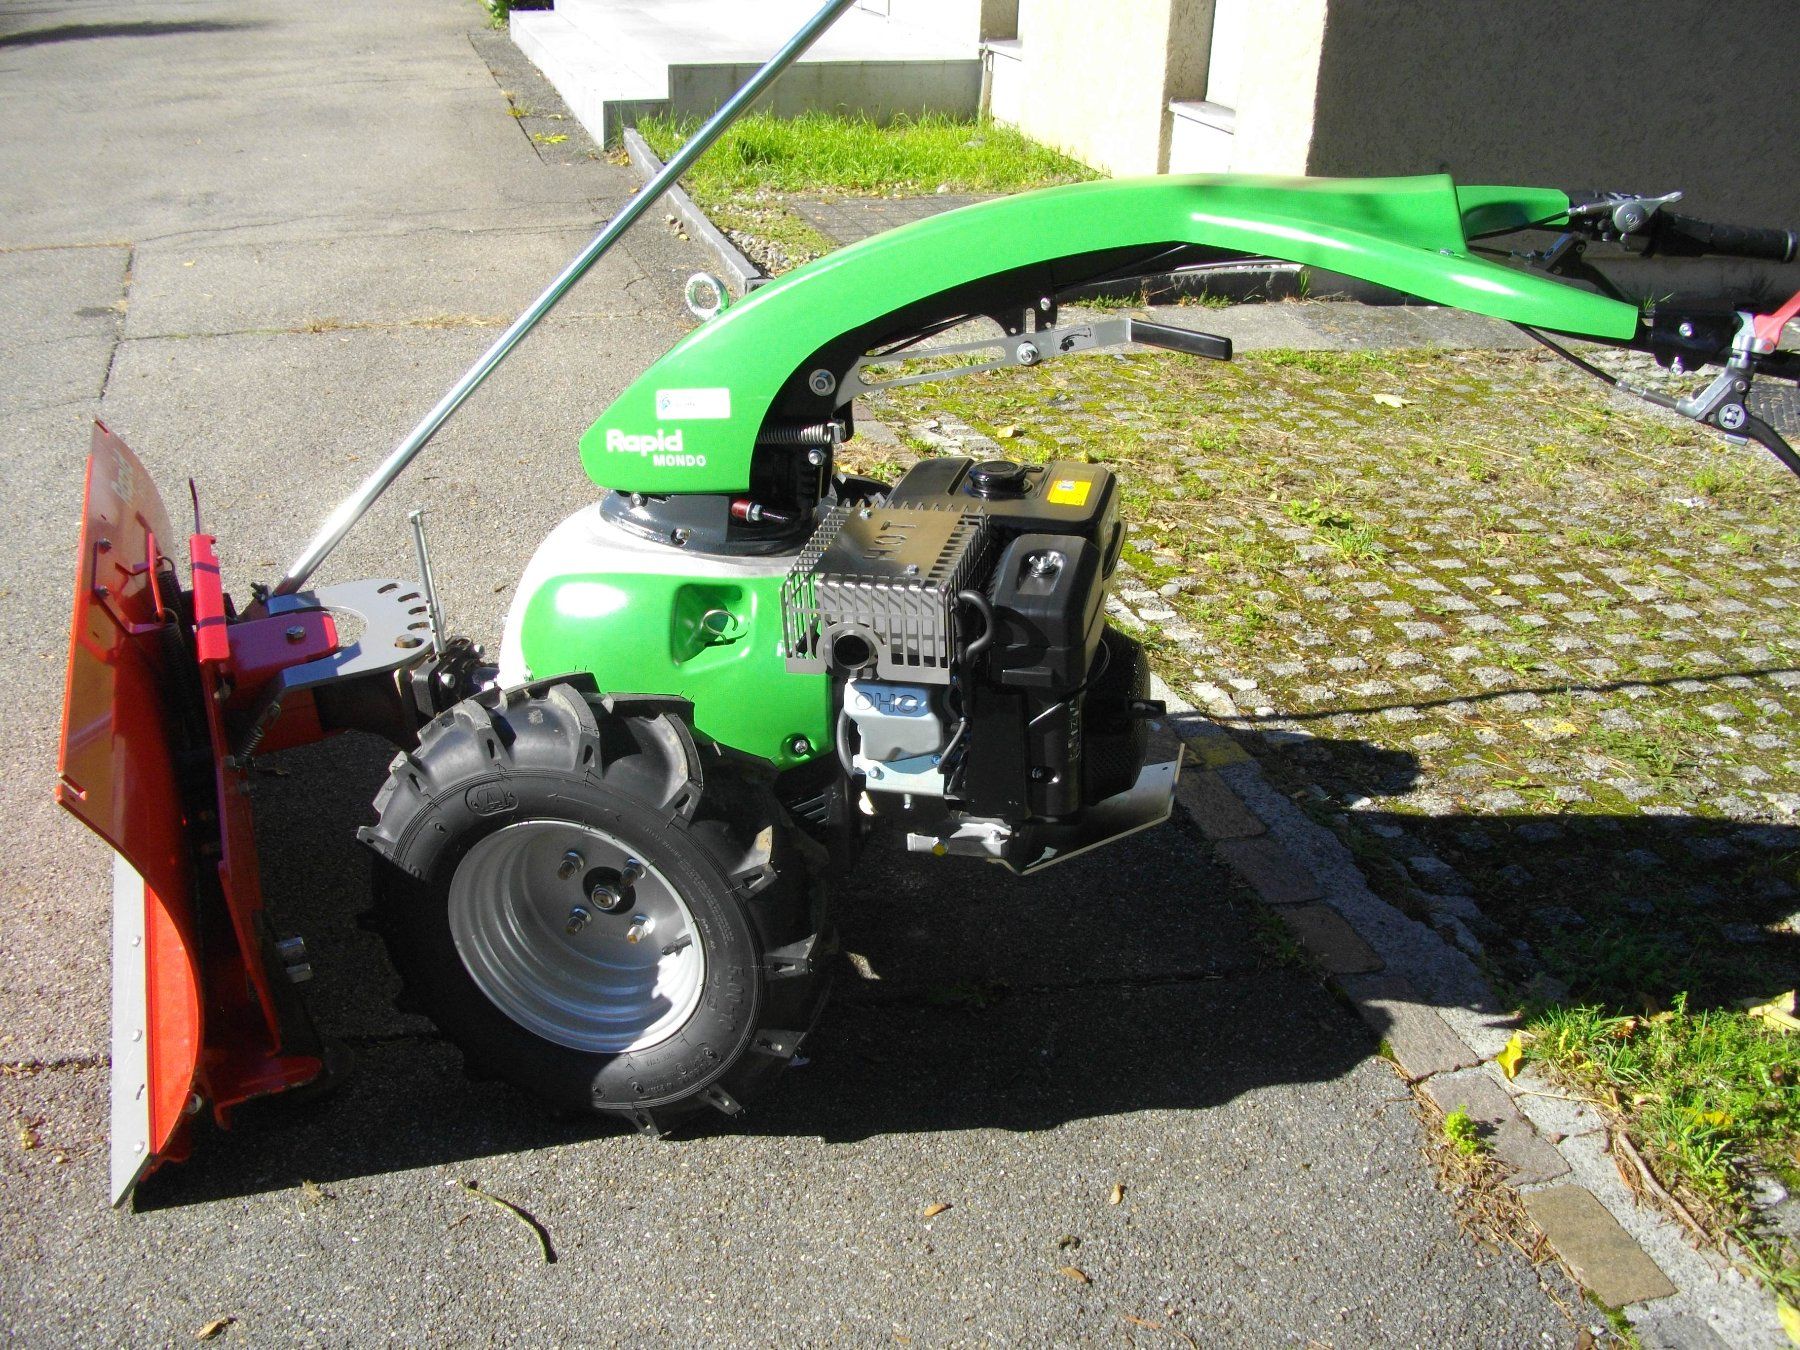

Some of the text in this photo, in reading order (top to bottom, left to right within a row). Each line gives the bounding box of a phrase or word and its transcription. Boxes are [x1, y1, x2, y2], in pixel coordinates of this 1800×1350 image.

[605, 428, 684, 457] Rapid
[652, 454, 707, 467] MONDO
[862, 519, 917, 561] HOT
[854, 691, 919, 714] OHC
